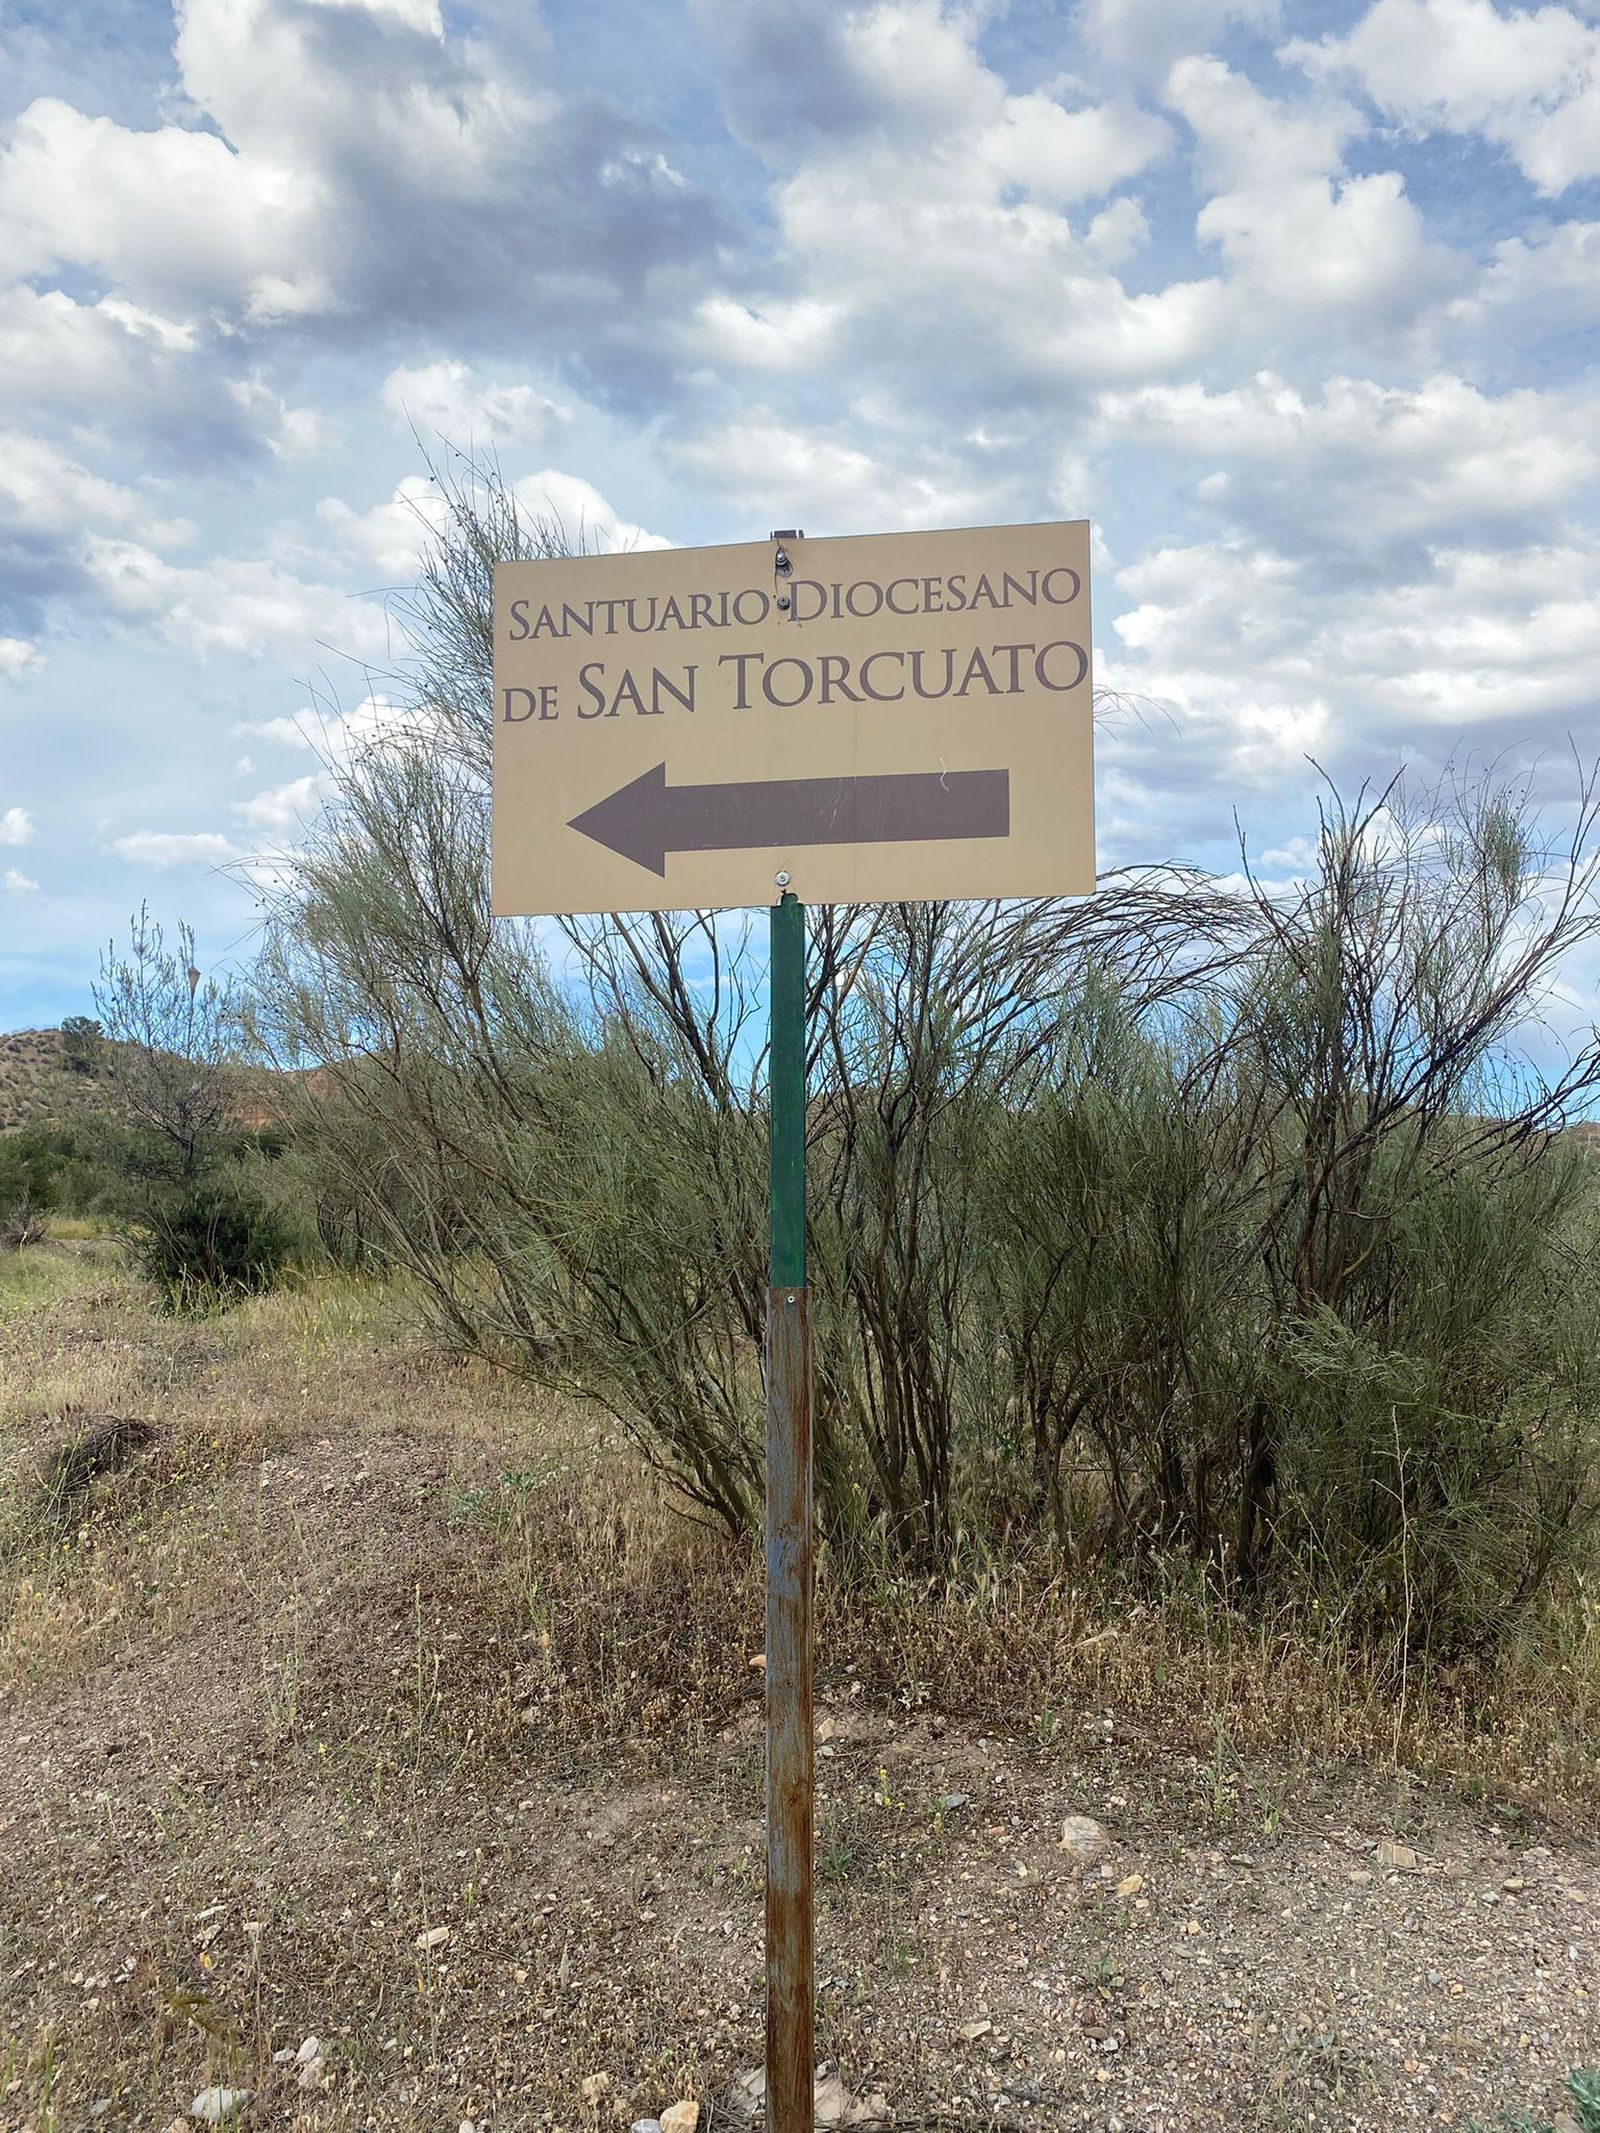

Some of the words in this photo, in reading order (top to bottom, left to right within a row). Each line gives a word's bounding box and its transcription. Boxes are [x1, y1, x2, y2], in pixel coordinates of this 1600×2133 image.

[509, 588, 770, 641] SANTUARIO
[786, 567, 1082, 623] DIOCESANO
[502, 684, 559, 723] DE
[577, 662, 699, 719] SAN
[718, 640, 1089, 710] TORCUATO
